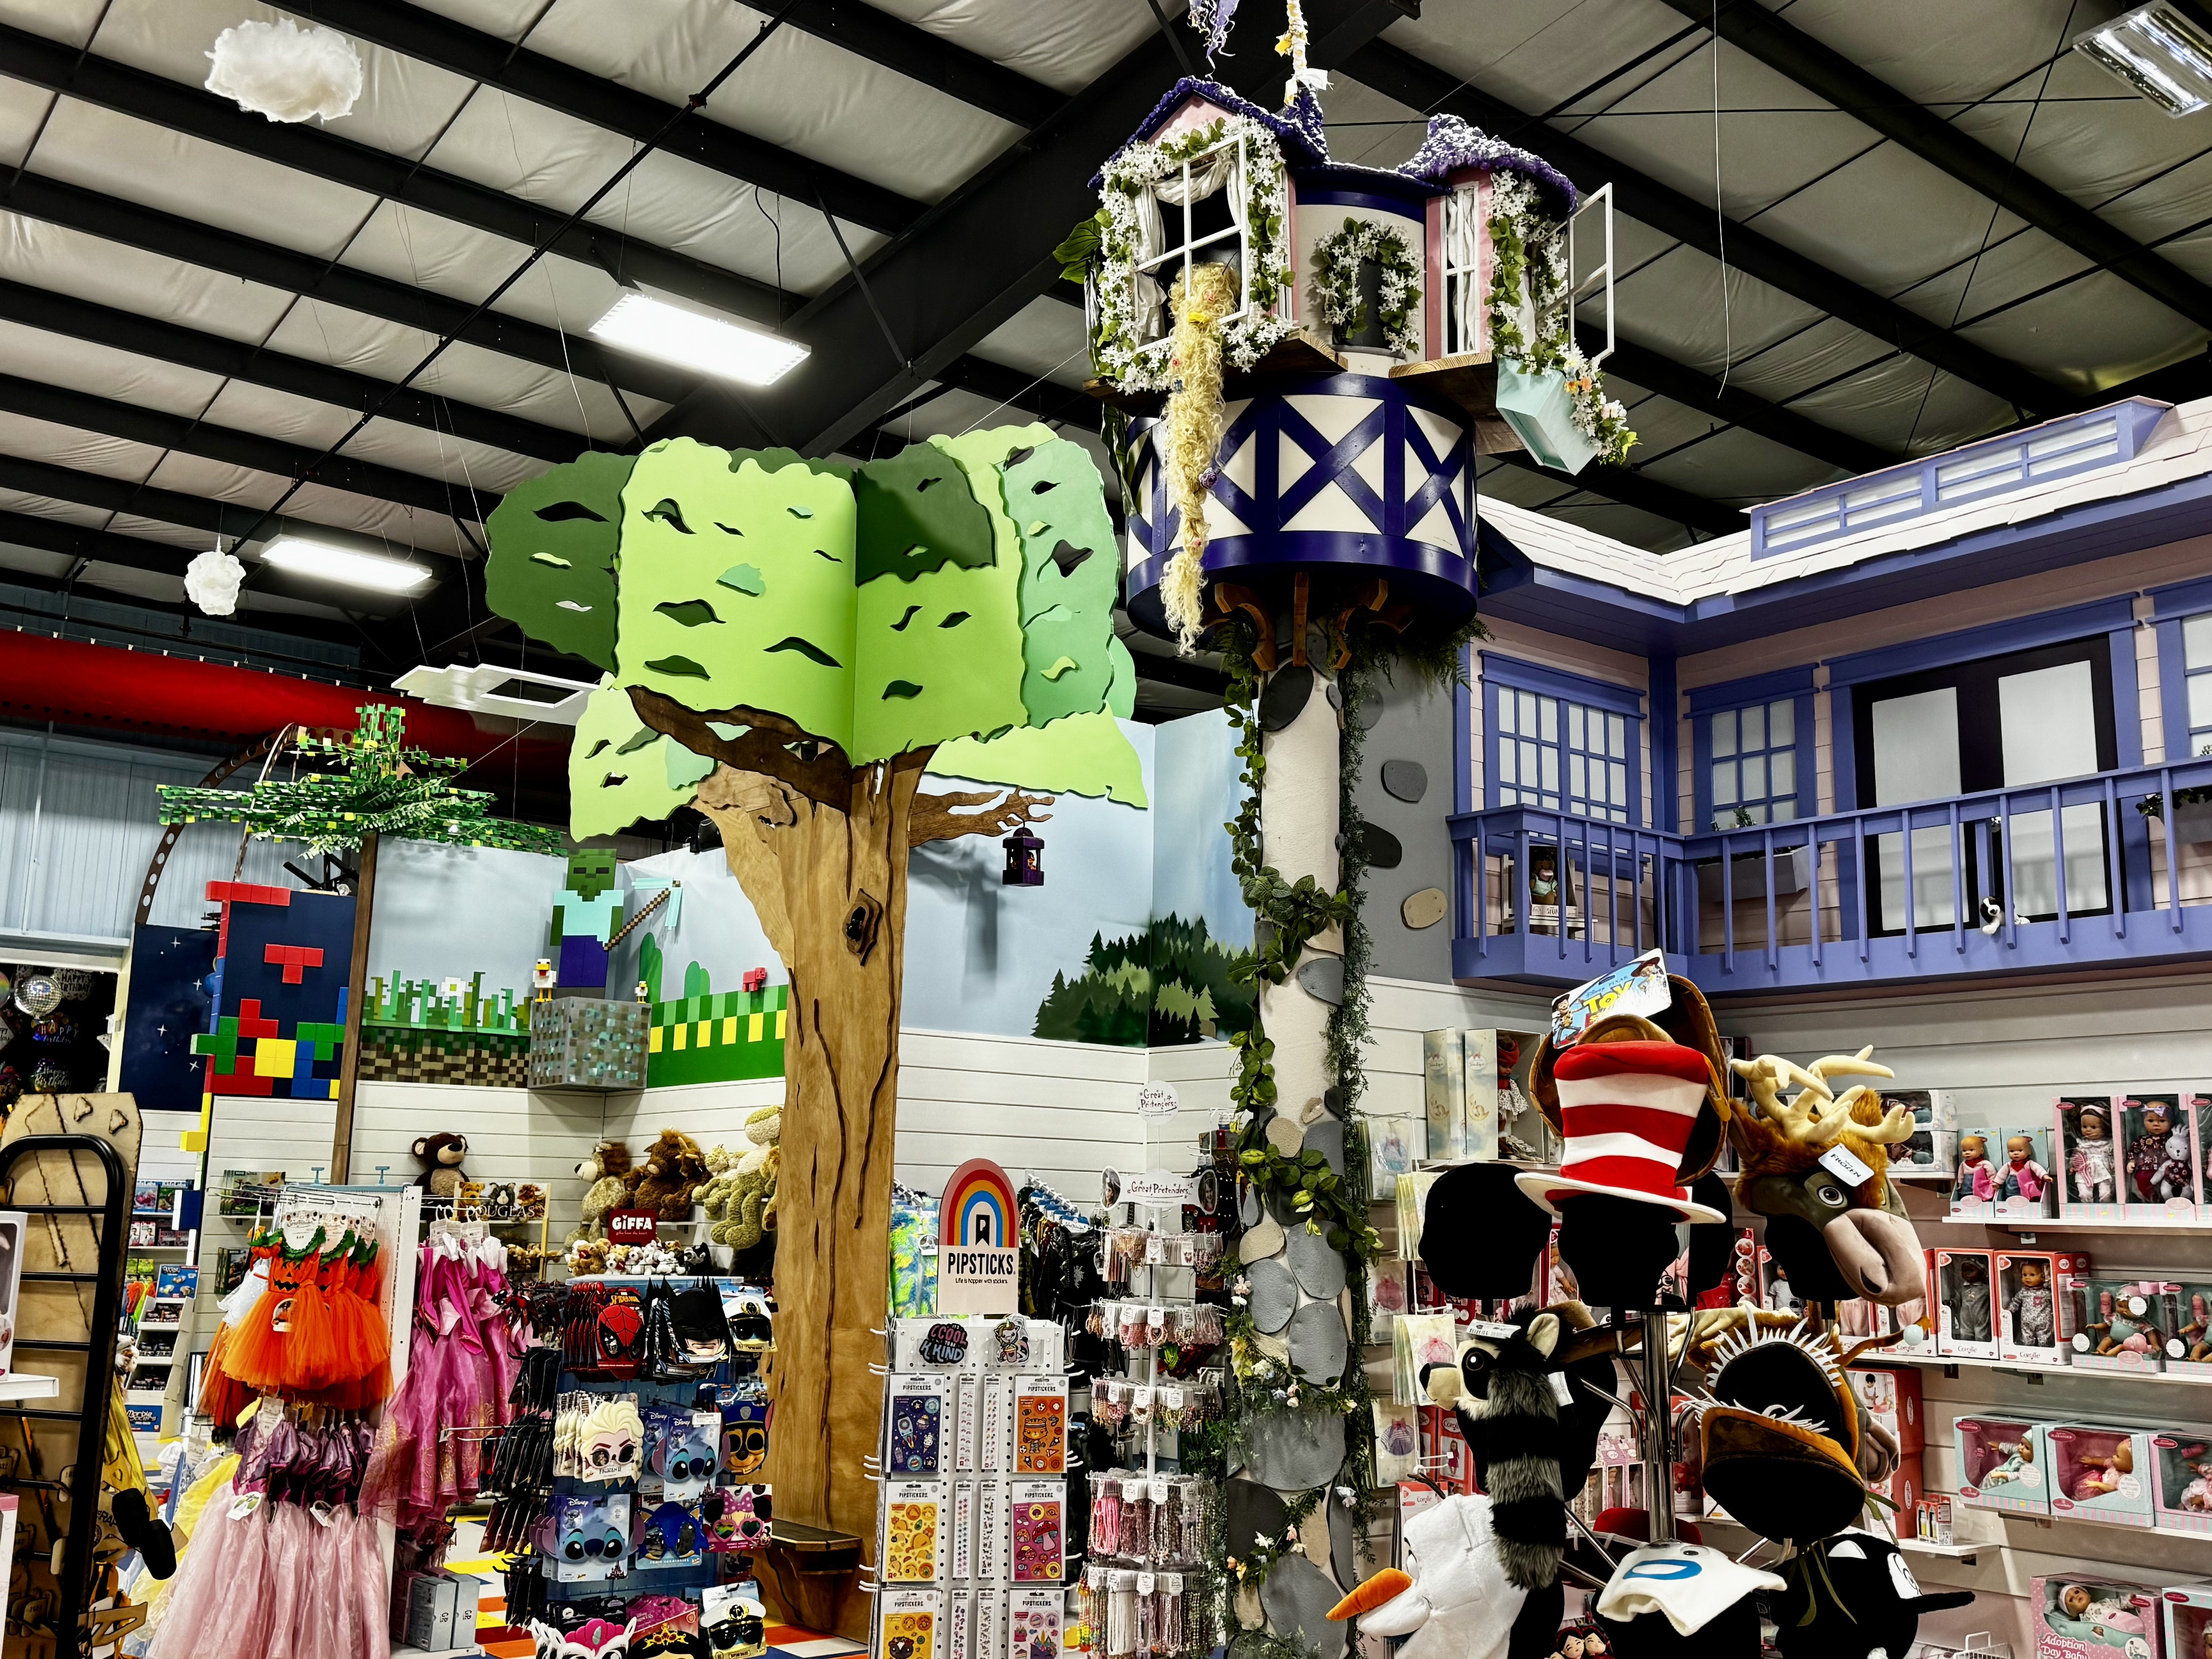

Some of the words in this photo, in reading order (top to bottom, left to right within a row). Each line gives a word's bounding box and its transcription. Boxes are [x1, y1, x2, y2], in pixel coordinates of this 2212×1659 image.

[62, 974, 85, 983] HAPPY
[1583, 978, 1635, 1014] TOY
[41, 1023, 79, 1038] HAPPY
[1144, 1089, 1163, 1099] Great
[1830, 1154, 1861, 1178] FROZEN
[1132, 1181, 1152, 1192] Great
[1153, 1183, 1188, 1194] Pretenders
[948, 1252, 1014, 1275] PIPSTICKS
[649, 1412, 667, 1421] Disney
[673, 1418, 690, 1427] Disney
[567, 1498, 589, 1507] Disney
[2040, 1635, 2085, 1651] Adoption
[2040, 1645, 2061, 1658] Day
